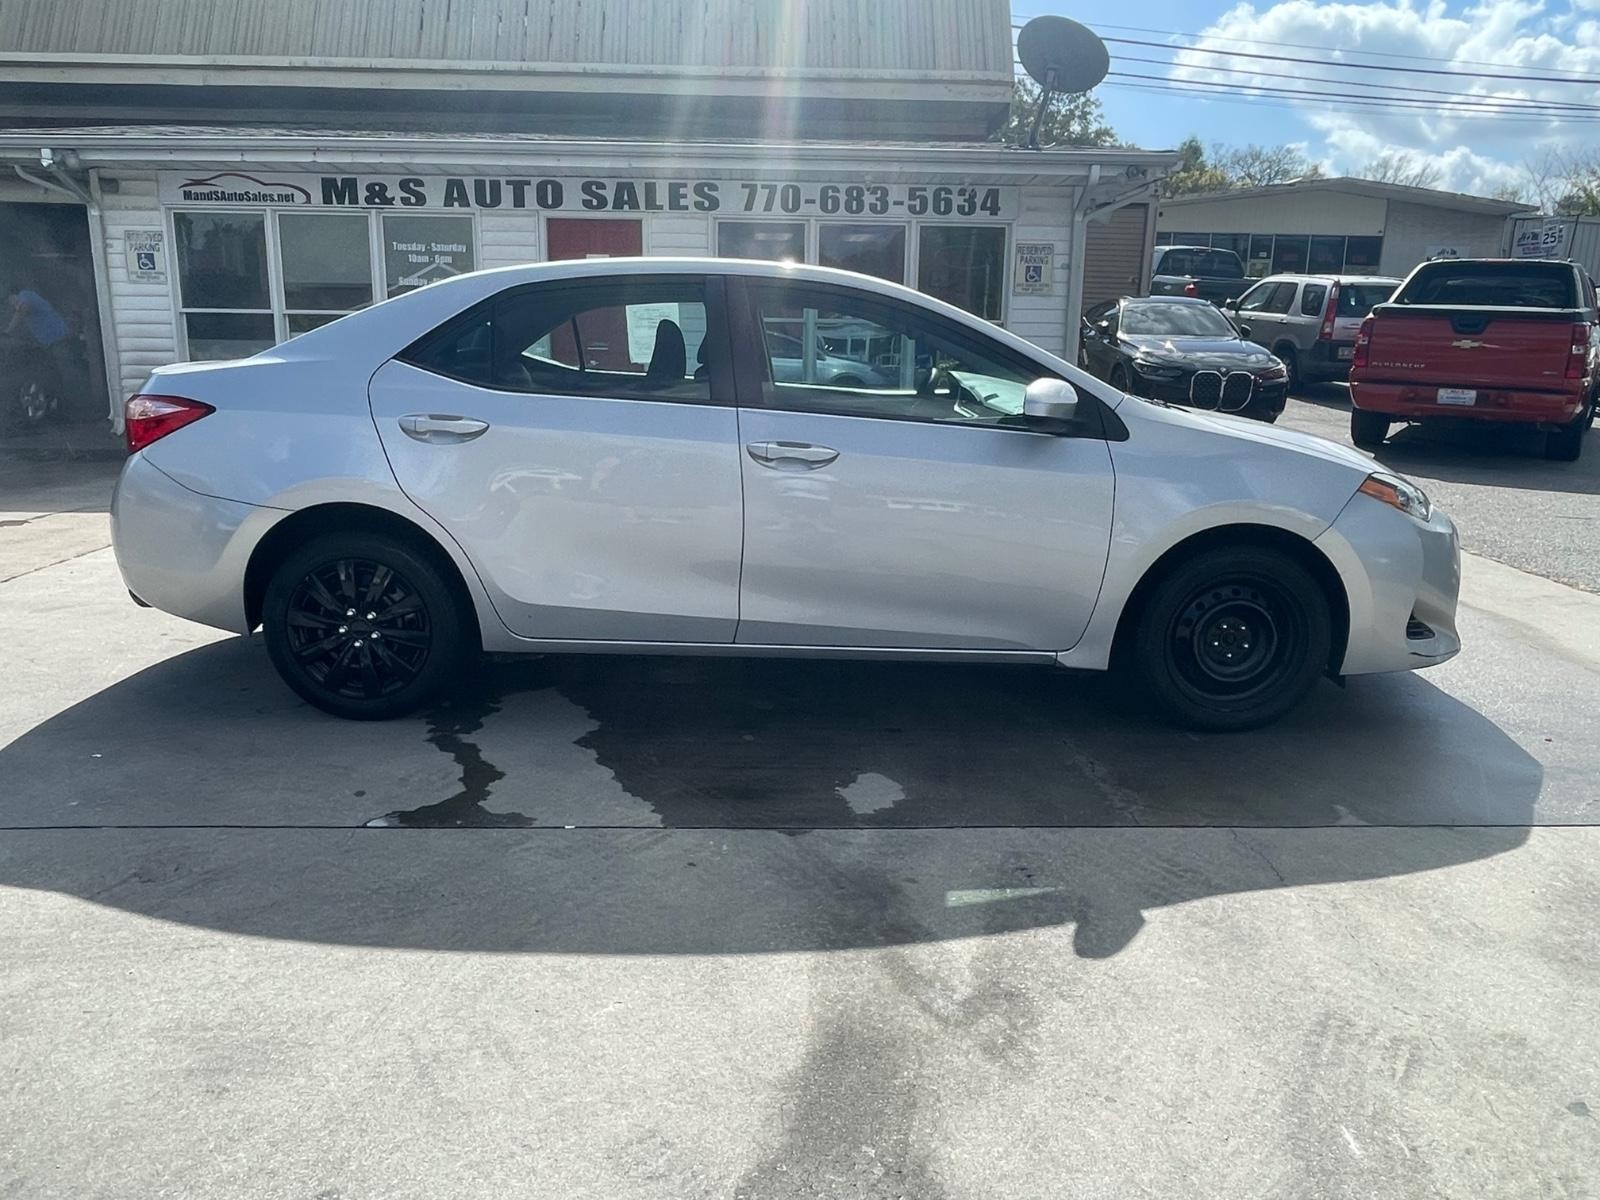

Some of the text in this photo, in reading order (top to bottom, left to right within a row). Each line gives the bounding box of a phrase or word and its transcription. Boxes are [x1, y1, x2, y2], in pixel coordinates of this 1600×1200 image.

[183, 190, 295, 203] MandSAutoSales.net
[321, 177, 1001, 216] M&S AUTO SALES 770-683-5634
[1543, 231, 1557, 245] 25
[392, 241, 426, 252] Tuesday
[431, 242, 466, 253] Saturday
[1016, 246, 1053, 256] RESERVED
[408, 254, 429, 263] 10am
[434, 254, 453, 264] 6pm
[1020, 255, 1050, 265] PARKING
